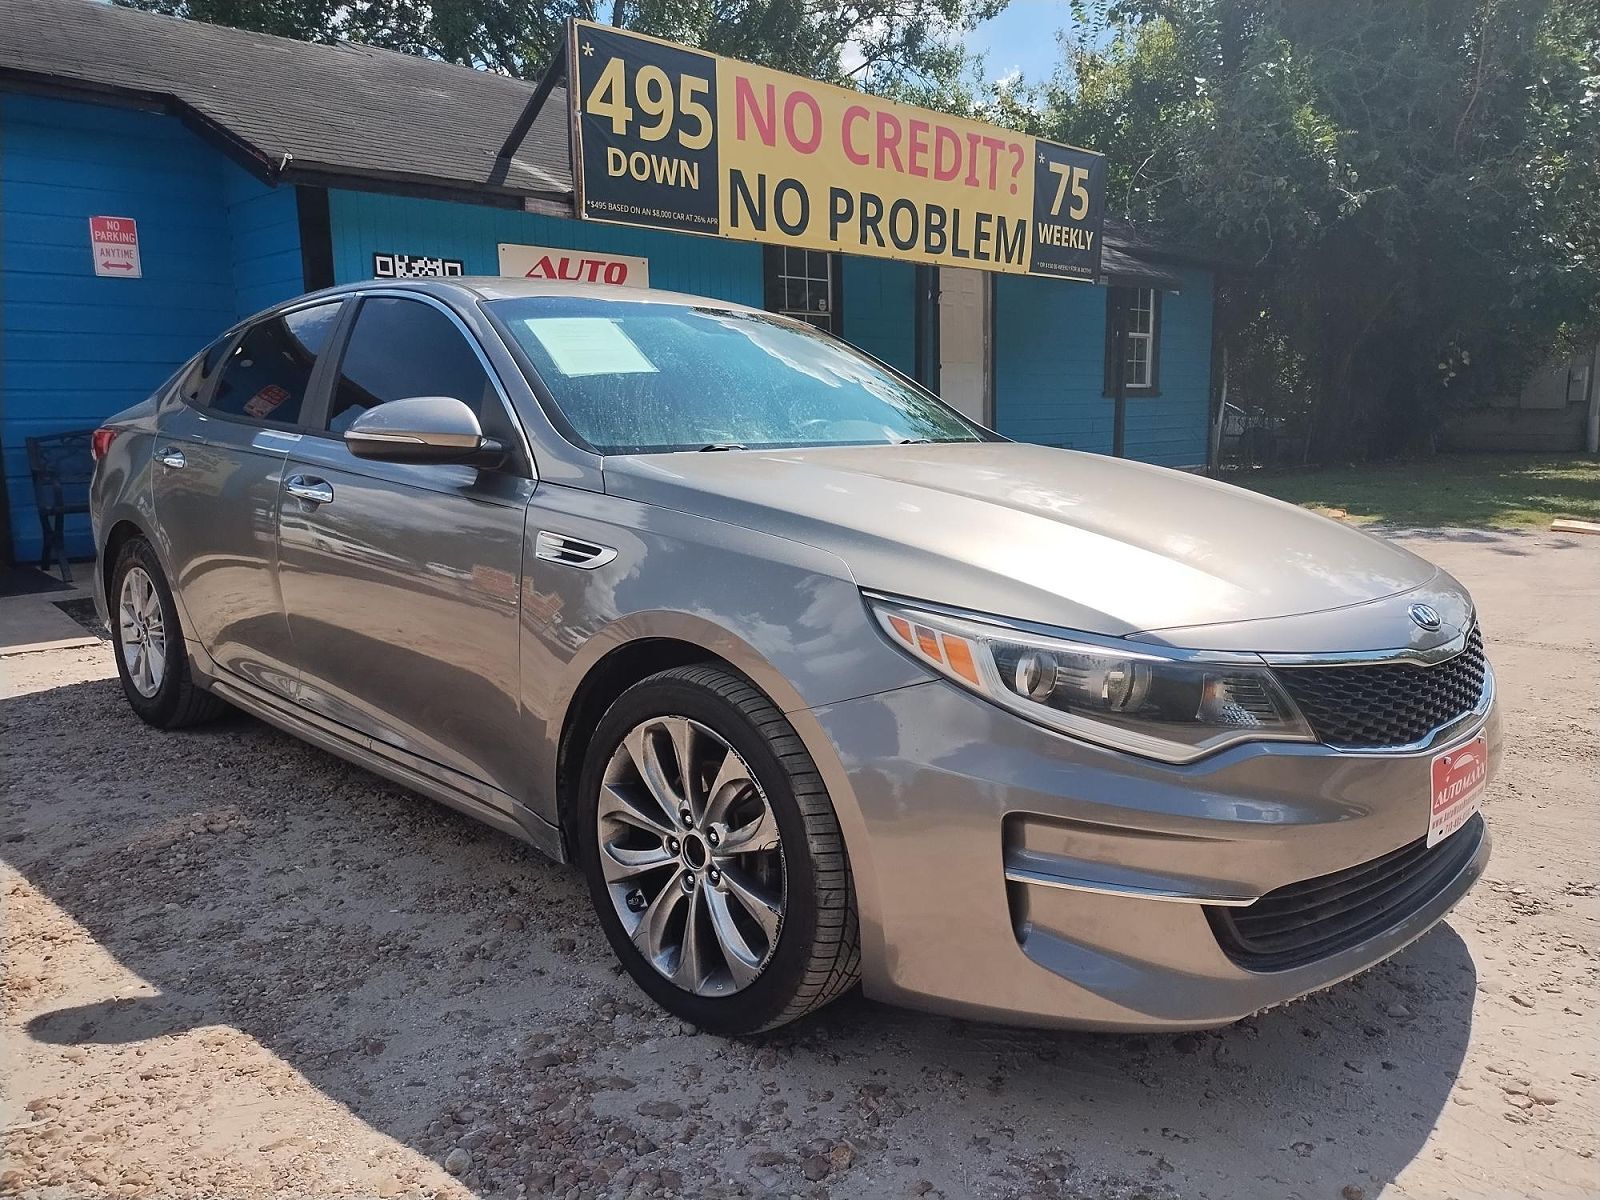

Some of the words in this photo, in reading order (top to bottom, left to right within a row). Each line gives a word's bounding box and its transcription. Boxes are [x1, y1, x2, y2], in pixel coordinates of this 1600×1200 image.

[586, 56, 714, 150] 495
[735, 76, 823, 155] NO
[841, 105, 1025, 195] CREDIT?
[607, 146, 699, 190] DOWN
[1049, 161, 1089, 220] 75
[106, 220, 120, 231] NO
[608, 202, 629, 213] BASED
[630, 206, 640, 214] ON
[641, 207, 651, 216] AN
[672, 212, 685, 220] CAR
[706, 217, 718, 225] APR
[729, 168, 810, 236] NO
[829, 186, 1027, 265] PROBLEM
[94, 231, 135, 243] PARKING
[1038, 222, 1094, 252] WEEKLY
[100, 247, 134, 259] ANYTIME
[525, 255, 628, 285] AUTO
